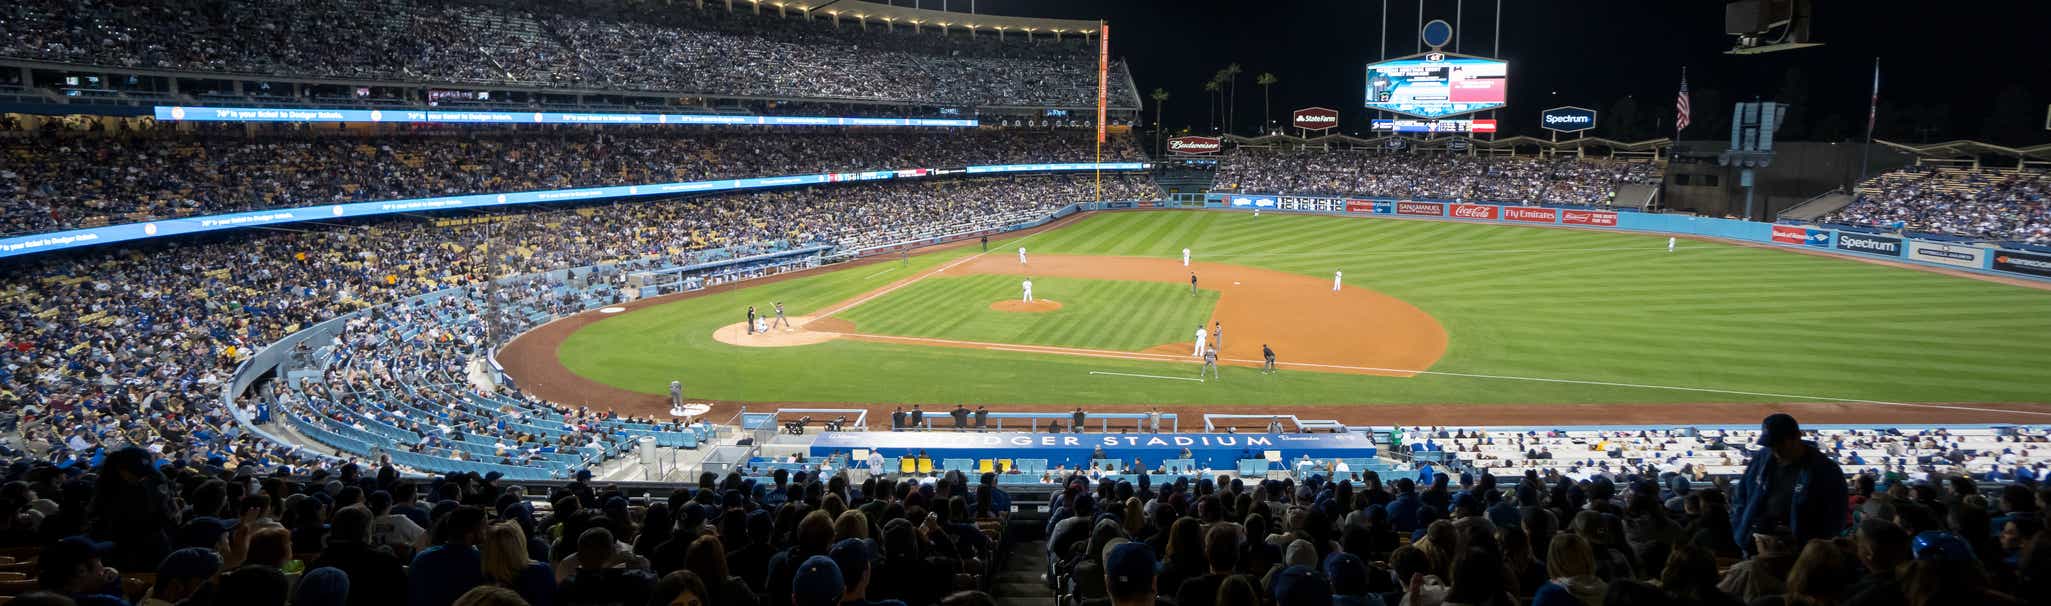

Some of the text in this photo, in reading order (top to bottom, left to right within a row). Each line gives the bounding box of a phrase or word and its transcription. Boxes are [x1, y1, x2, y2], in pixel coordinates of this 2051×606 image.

[1546, 115, 1588, 124] Spectrum
[1170, 140, 1218, 150] Budweiser
[1455, 206, 1490, 218] Coca-Cola
[1505, 209, 1519, 218] Fly
[1520, 210, 1555, 219] Emirates
[1840, 235, 1894, 252] Spectrum
[1104, 436, 1272, 447] STADIUM
